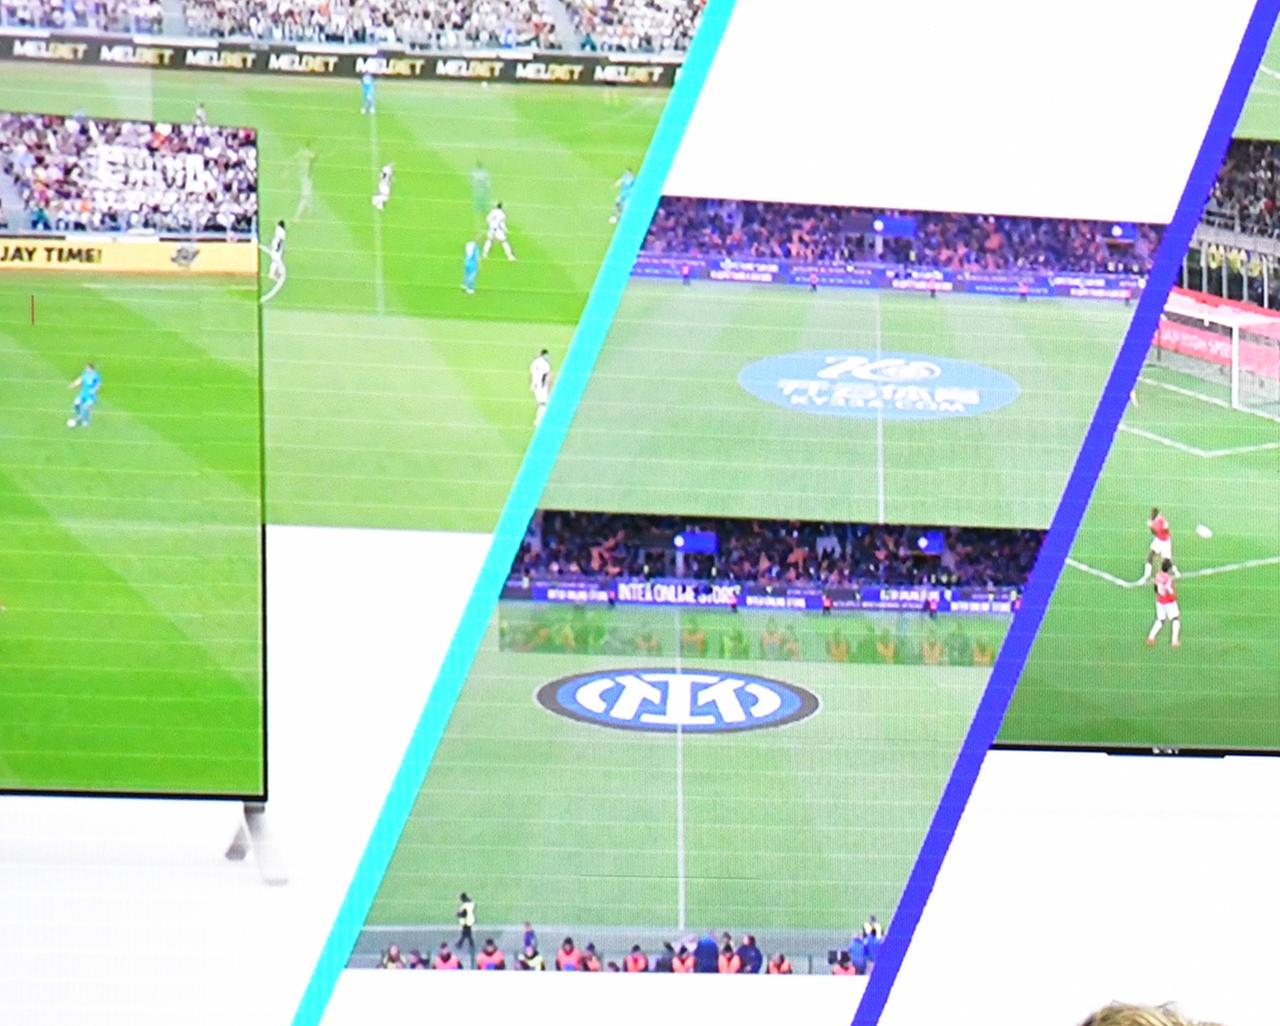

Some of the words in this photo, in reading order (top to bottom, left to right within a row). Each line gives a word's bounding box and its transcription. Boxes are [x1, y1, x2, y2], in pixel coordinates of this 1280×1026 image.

[13, 39, 87, 59] MELBET
[100, 44, 174, 65] MELBET
[185, 48, 257, 68] MELBET
[268, 53, 339, 73] MELBET
[355, 57, 425, 76] MELBET
[435, 60, 504, 77] MELBET
[515, 63, 584, 81] MELBET
[593, 65, 664, 83] MELBET
